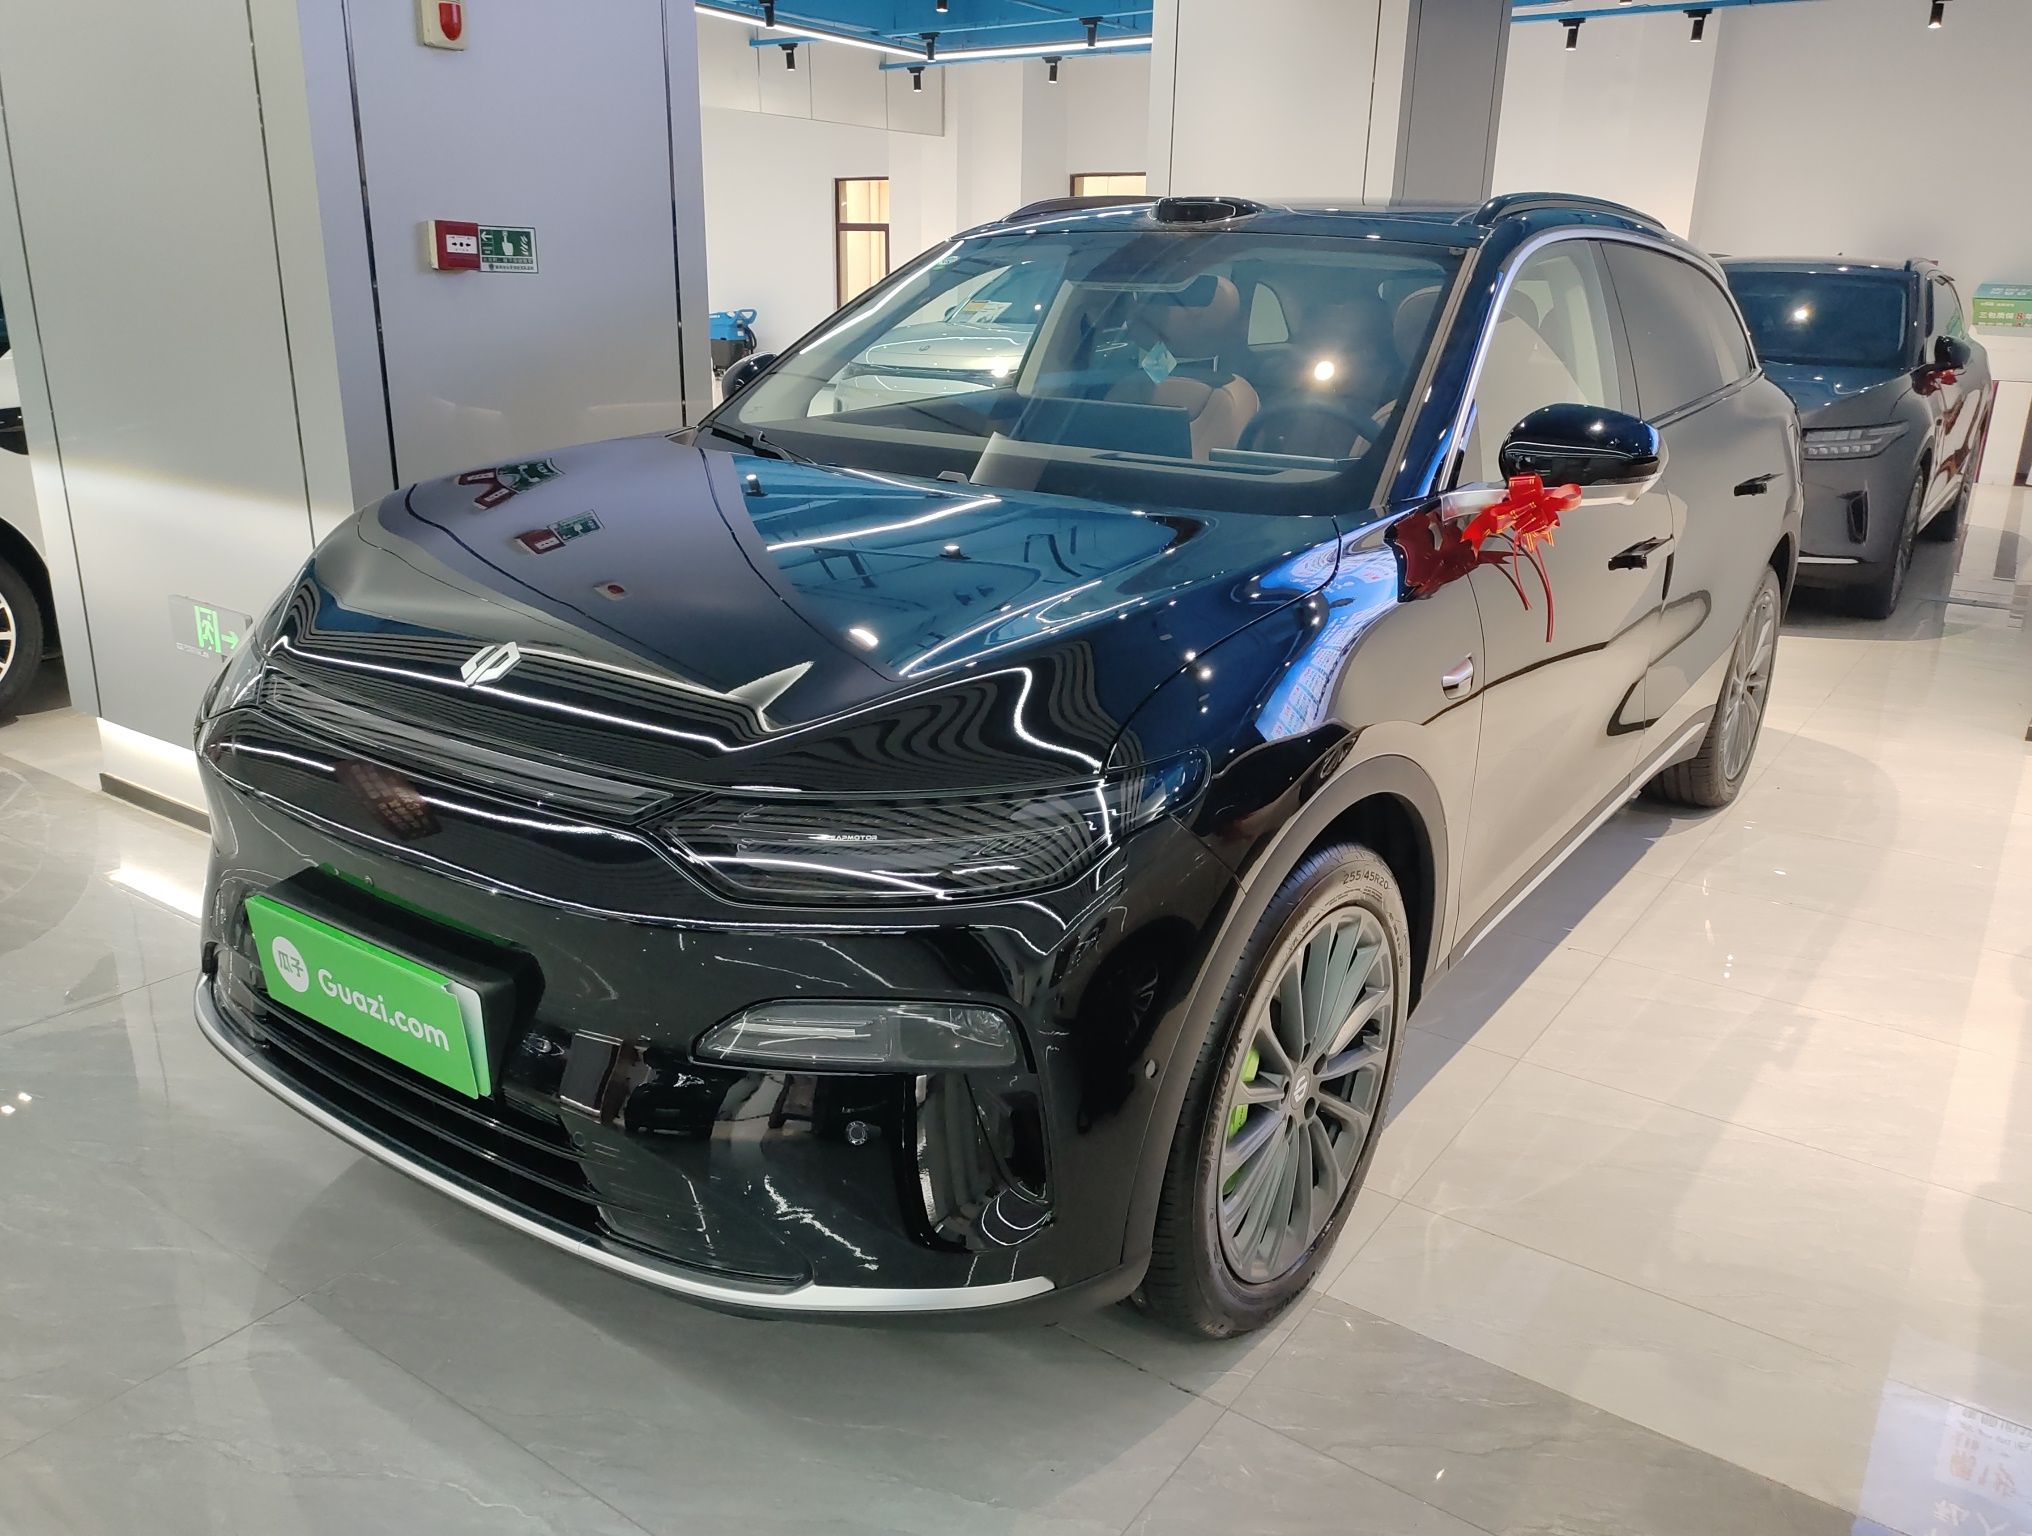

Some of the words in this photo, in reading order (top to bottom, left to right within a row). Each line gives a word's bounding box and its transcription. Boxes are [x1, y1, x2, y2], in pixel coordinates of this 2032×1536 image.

[1342, 869, 1389, 890] 255/45R20
[278, 950, 304, 978] 瓜子
[318, 969, 449, 1052] Guazi.com
